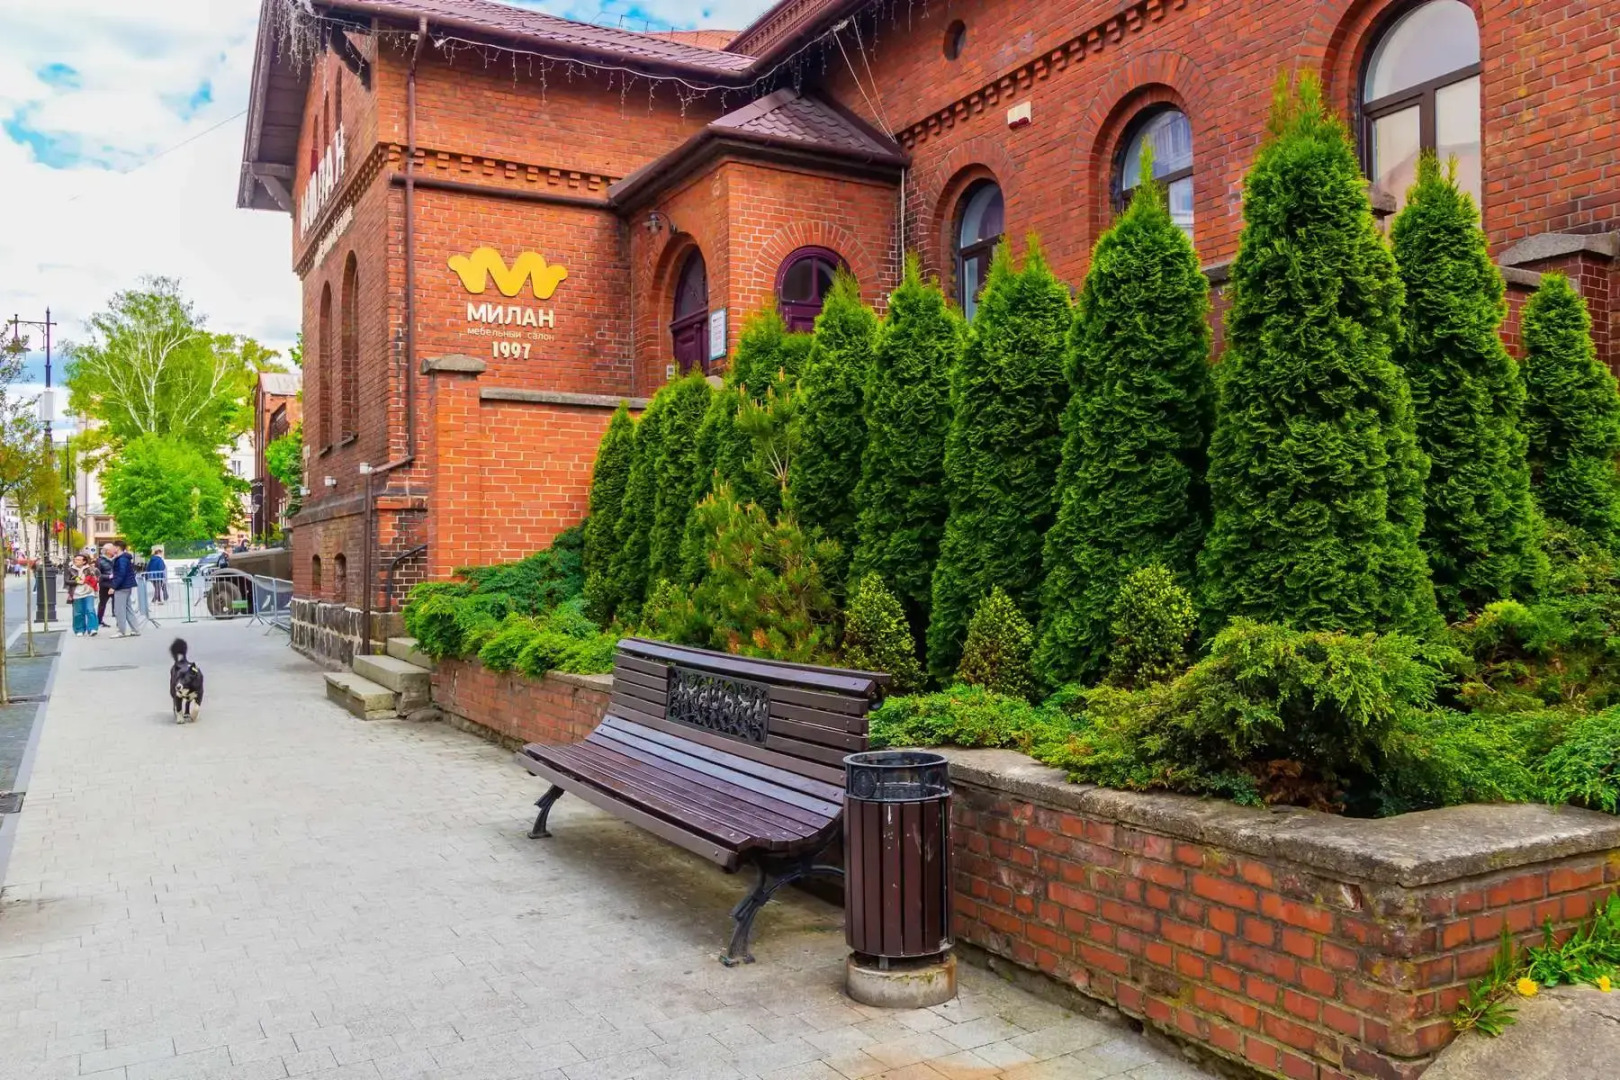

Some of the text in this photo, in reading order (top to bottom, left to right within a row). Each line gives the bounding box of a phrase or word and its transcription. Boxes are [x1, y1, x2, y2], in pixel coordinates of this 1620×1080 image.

[467, 302, 554, 328] МИЛАН
[527, 331, 555, 341] салон
[492, 341, 531, 359] 1997
